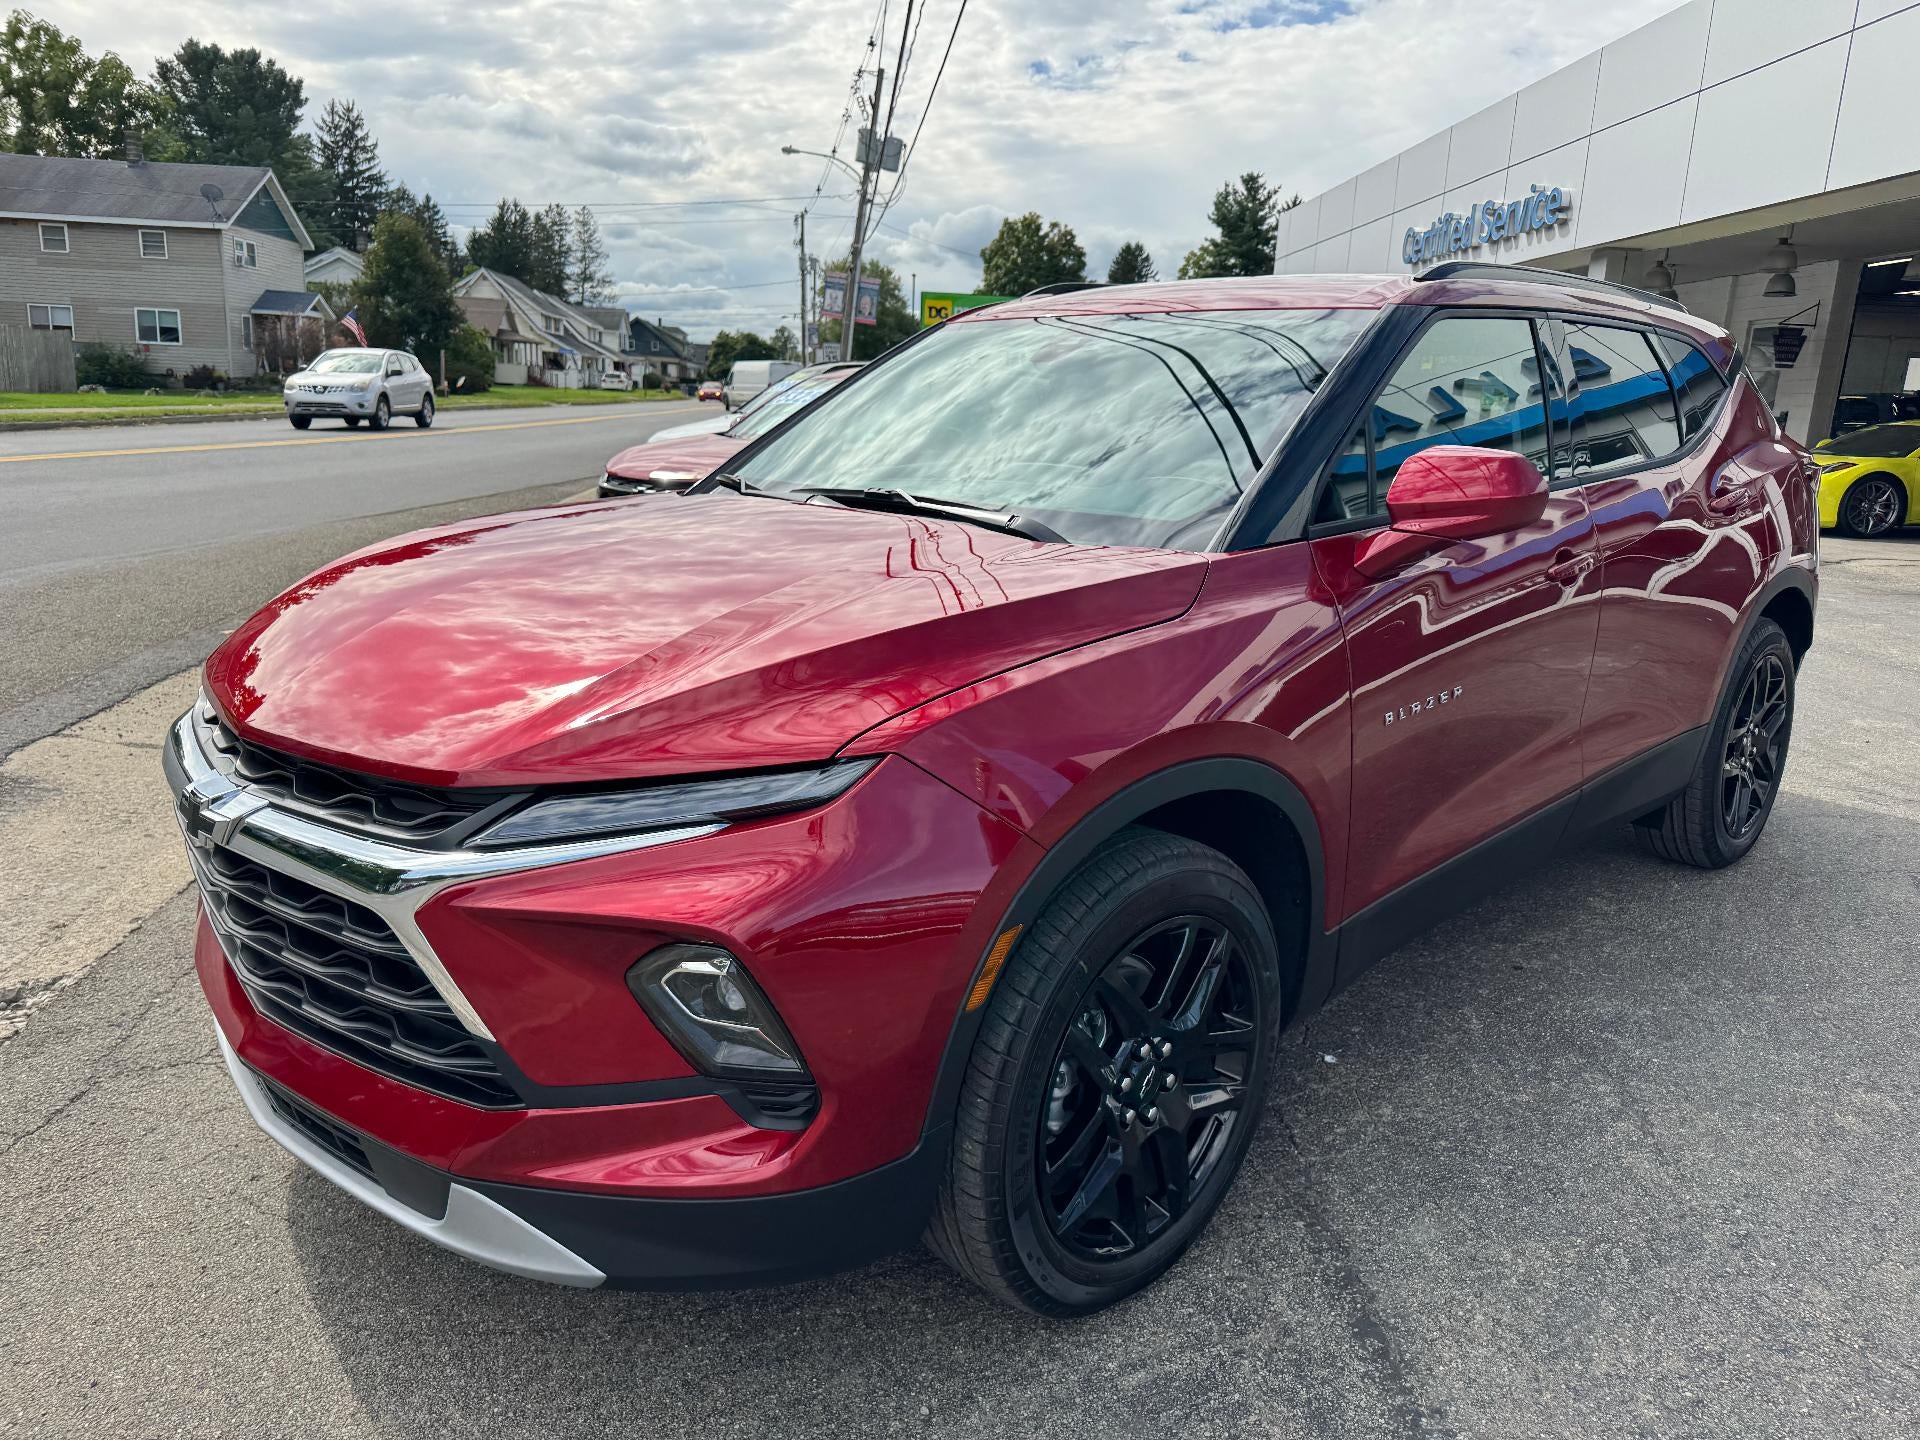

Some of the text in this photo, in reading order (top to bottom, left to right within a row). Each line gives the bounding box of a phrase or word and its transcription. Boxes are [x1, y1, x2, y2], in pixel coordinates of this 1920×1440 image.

[1402, 184, 1566, 264] Certified Service
[928, 305, 948, 319] DG
[1385, 686, 1463, 726] BLAZER
